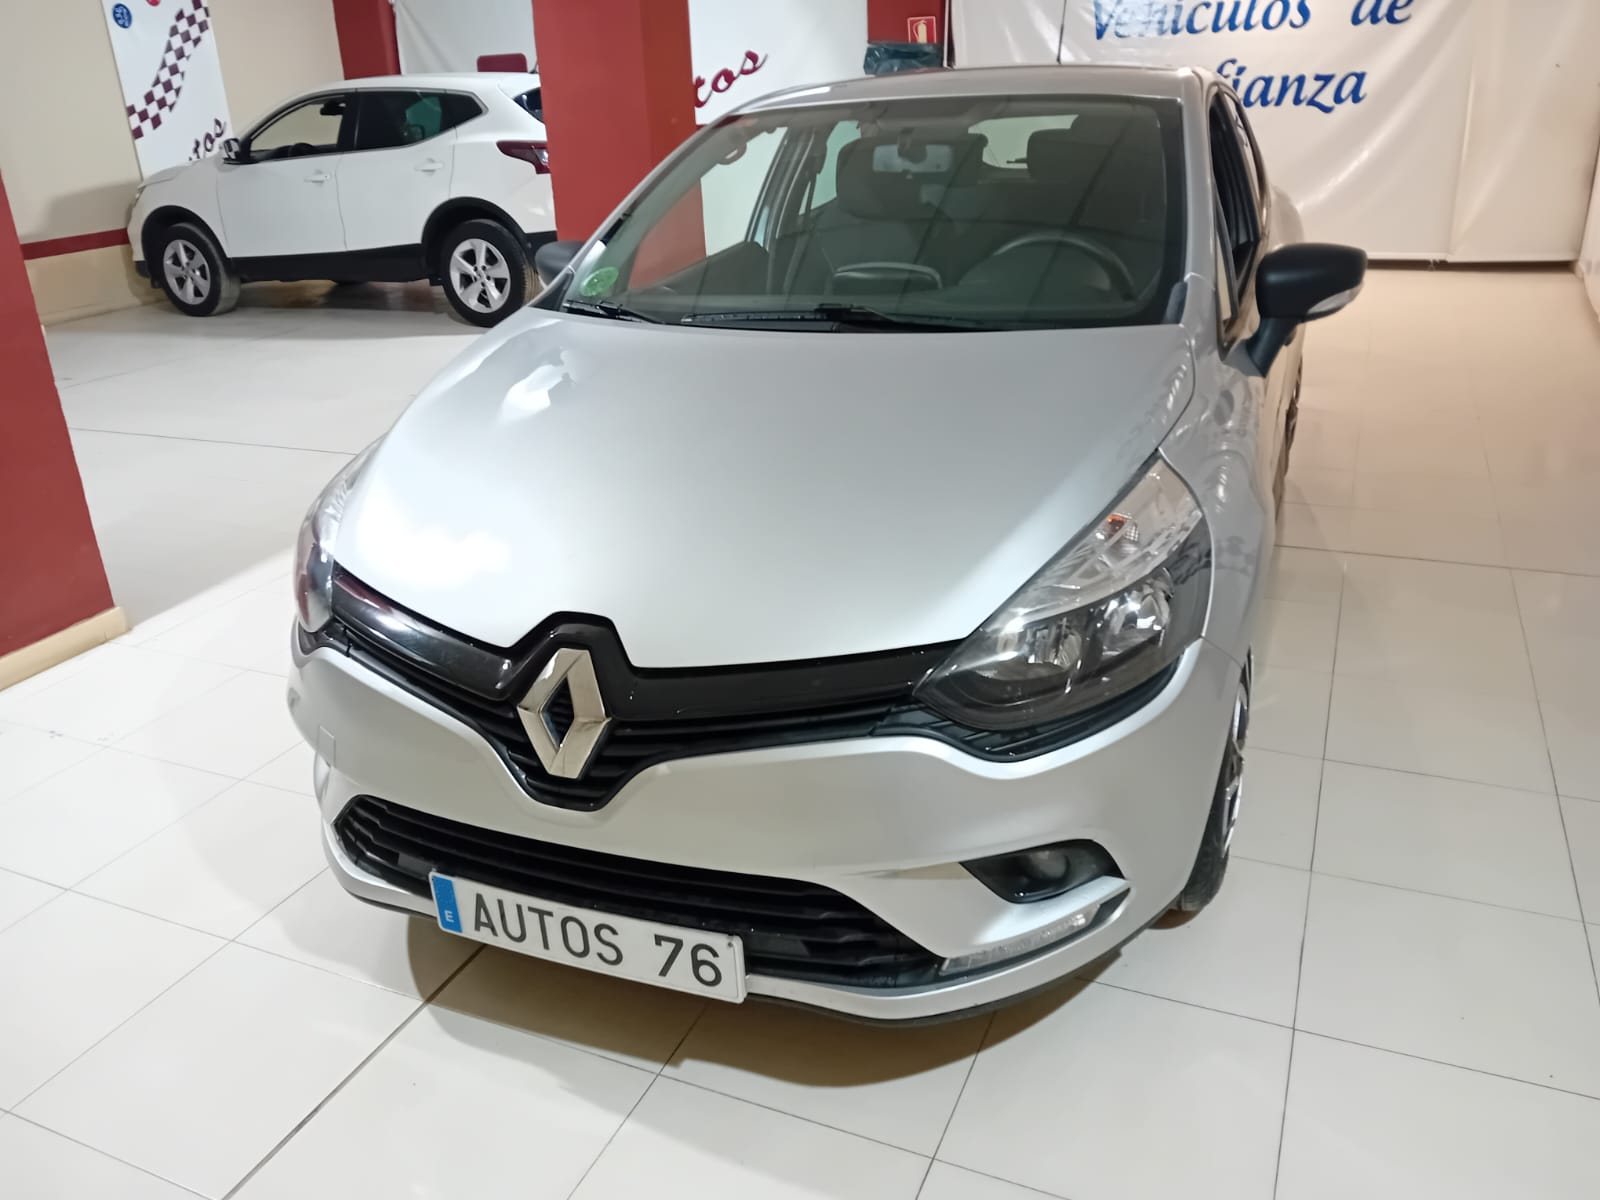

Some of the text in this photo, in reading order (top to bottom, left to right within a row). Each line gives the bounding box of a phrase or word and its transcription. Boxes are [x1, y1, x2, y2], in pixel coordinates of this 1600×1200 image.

[444, 910, 454, 923] E
[474, 893, 722, 987] AUTOS 76
